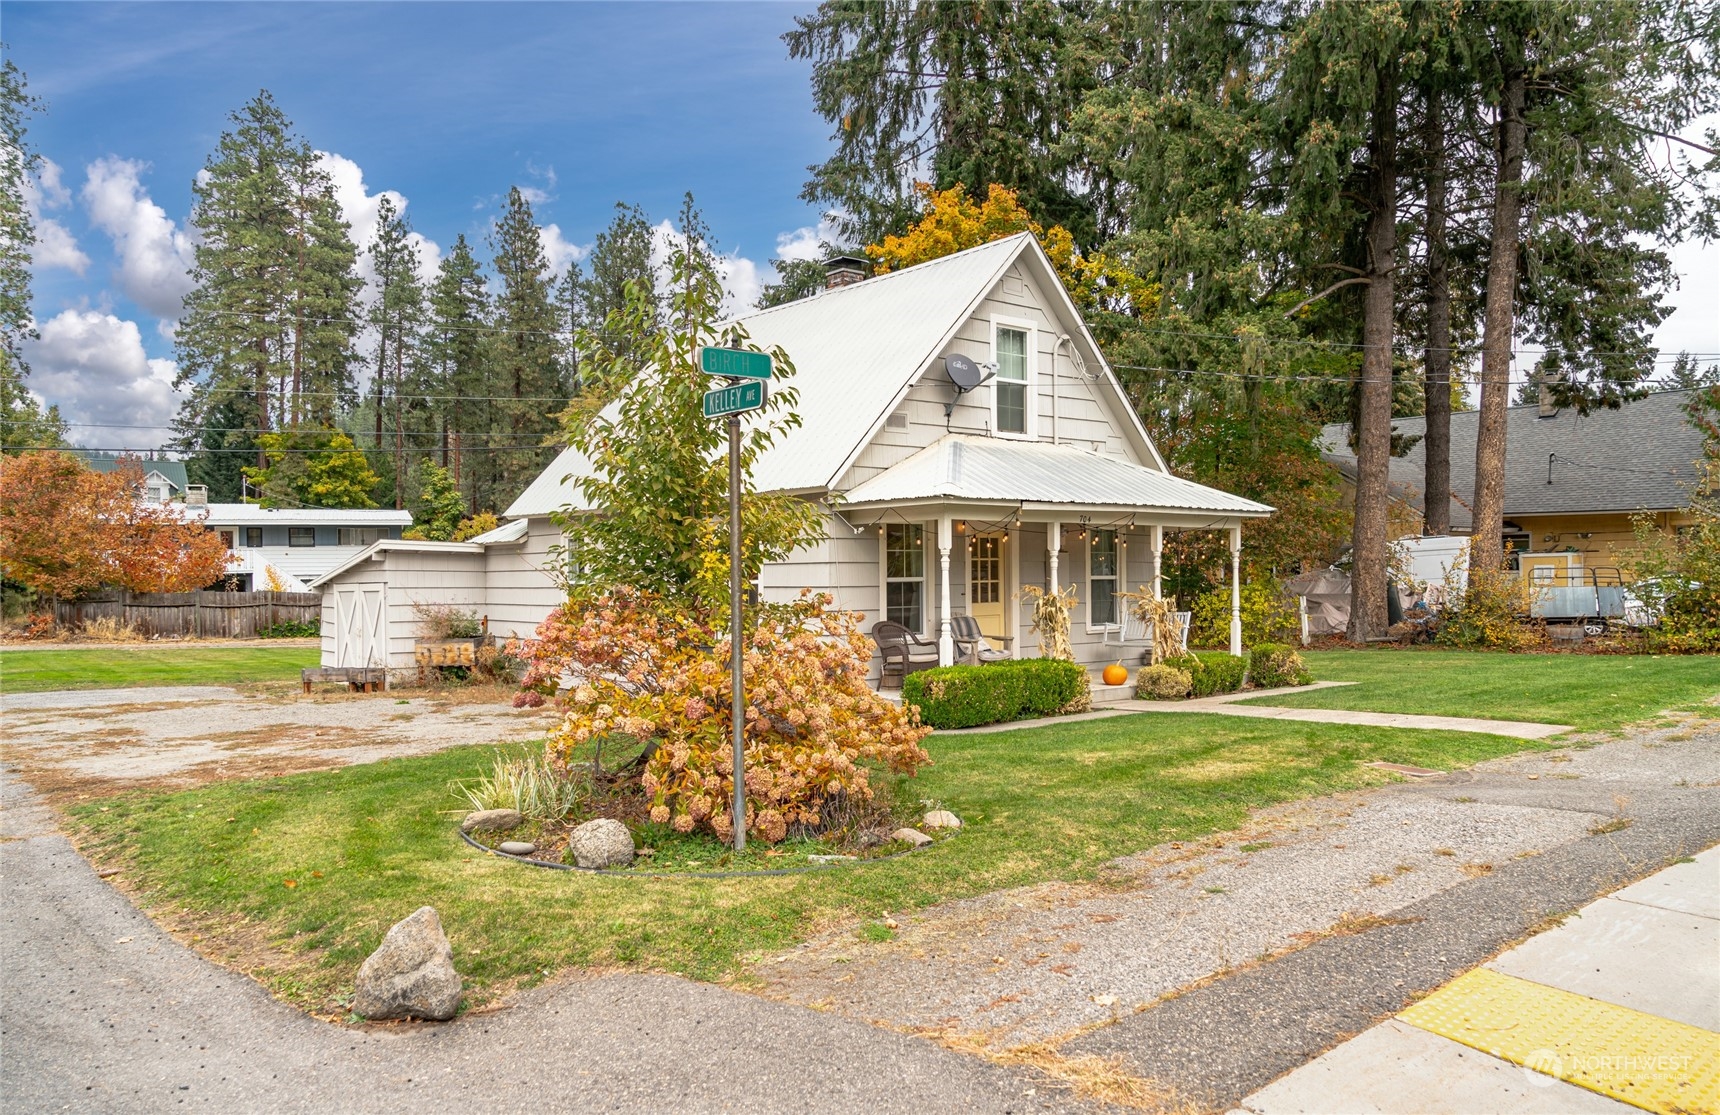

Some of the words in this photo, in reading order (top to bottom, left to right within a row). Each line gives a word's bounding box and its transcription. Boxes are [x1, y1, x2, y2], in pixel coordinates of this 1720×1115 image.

[709, 351, 750, 374] BIRCH
[709, 388, 742, 414] KELLEY
[746, 389, 755, 402] AVE
[1079, 514, 1092, 523] 704
